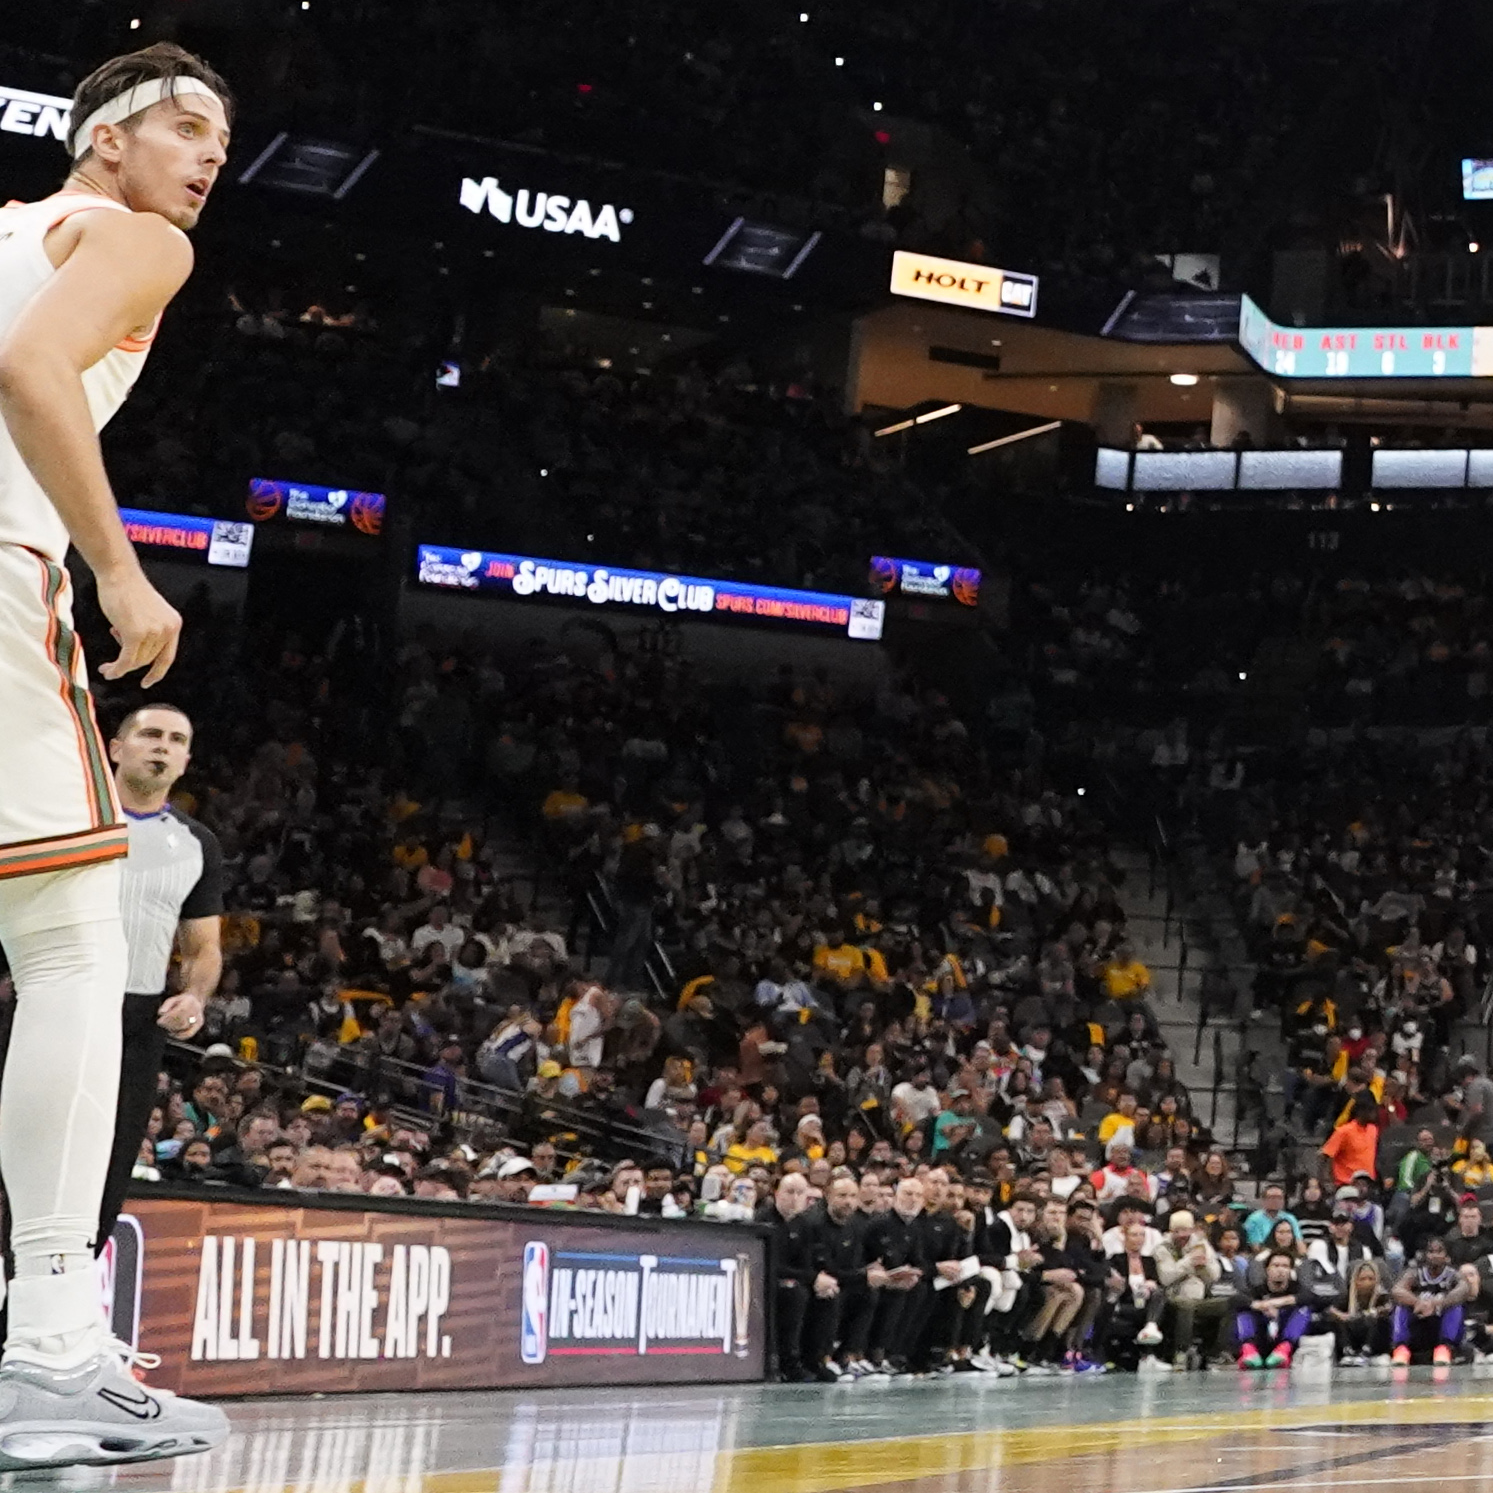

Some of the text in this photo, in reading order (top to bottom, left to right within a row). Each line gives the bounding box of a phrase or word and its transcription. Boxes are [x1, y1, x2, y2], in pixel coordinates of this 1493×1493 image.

[515, 189, 621, 243] USAA
[914, 270, 990, 293] HOLT
[1321, 334, 1358, 350] AST
[1374, 334, 1408, 350] STL
[512, 560, 588, 596] SPURS
[588, 570, 656, 605] SILVER
[658, 577, 715, 612] CLUB
[192, 1236, 452, 1361] ALL IN THE APP.
[549, 1255, 737, 1355] IN-SEASON TOURNAMENT
